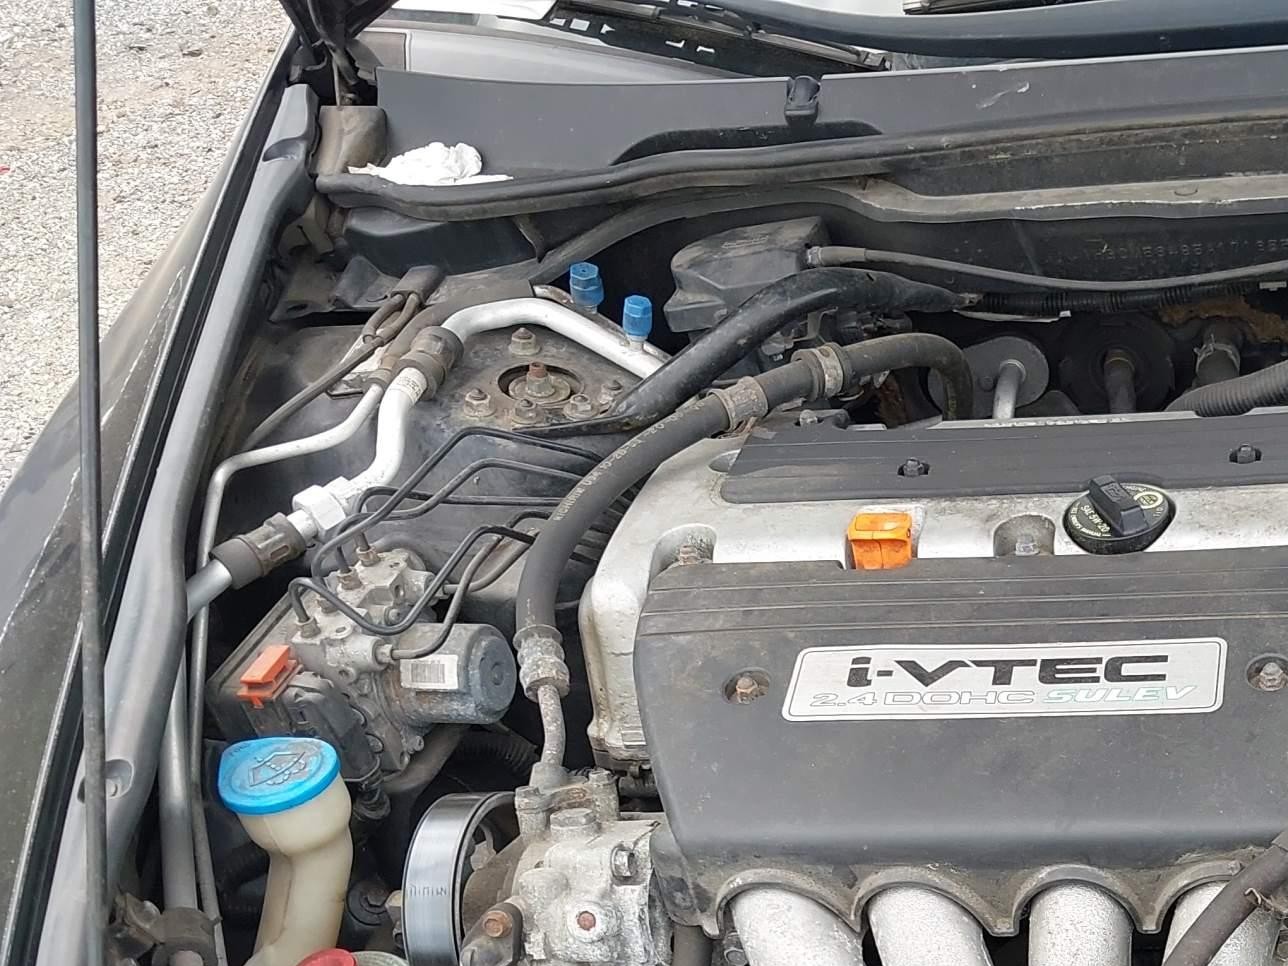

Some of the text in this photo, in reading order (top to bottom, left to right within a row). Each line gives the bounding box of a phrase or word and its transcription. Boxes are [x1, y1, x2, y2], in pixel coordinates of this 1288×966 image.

[845, 654, 1169, 688] i-VTEC
[809, 684, 1198, 707] 2.4 DOHC SULEV
